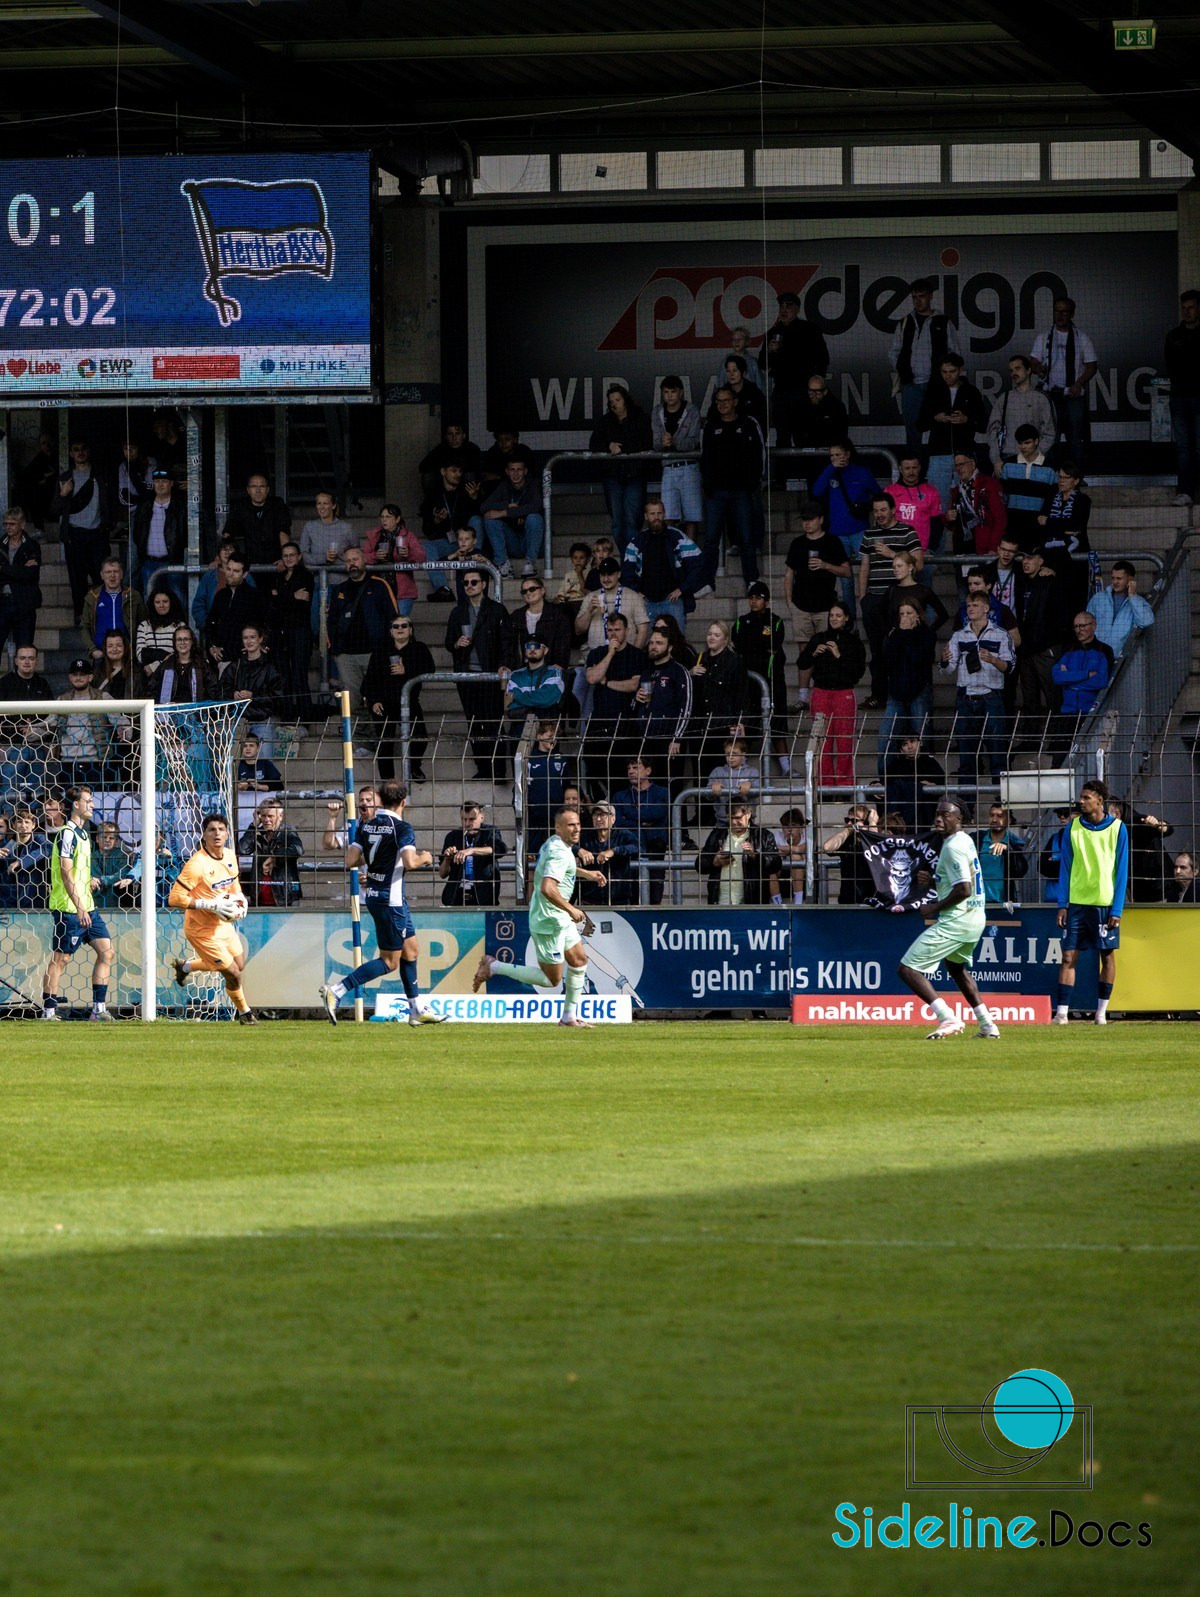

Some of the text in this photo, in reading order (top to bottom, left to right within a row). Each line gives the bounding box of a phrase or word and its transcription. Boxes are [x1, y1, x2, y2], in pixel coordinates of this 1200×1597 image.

[6, 191, 96, 246] 0:1
[636, 247, 1069, 354] pro deign
[28, 359, 61, 375] Liebe
[100, 358, 133, 373] EWP
[279, 361, 347, 372] MIETHKE
[367, 834, 383, 865] 7
[651, 920, 790, 955] Komm, wir
[976, 936, 1063, 965] ALIA
[326, 928, 459, 988] SP
[817, 961, 882, 989] KINO
[808, 1001, 915, 1020] nahkauf
